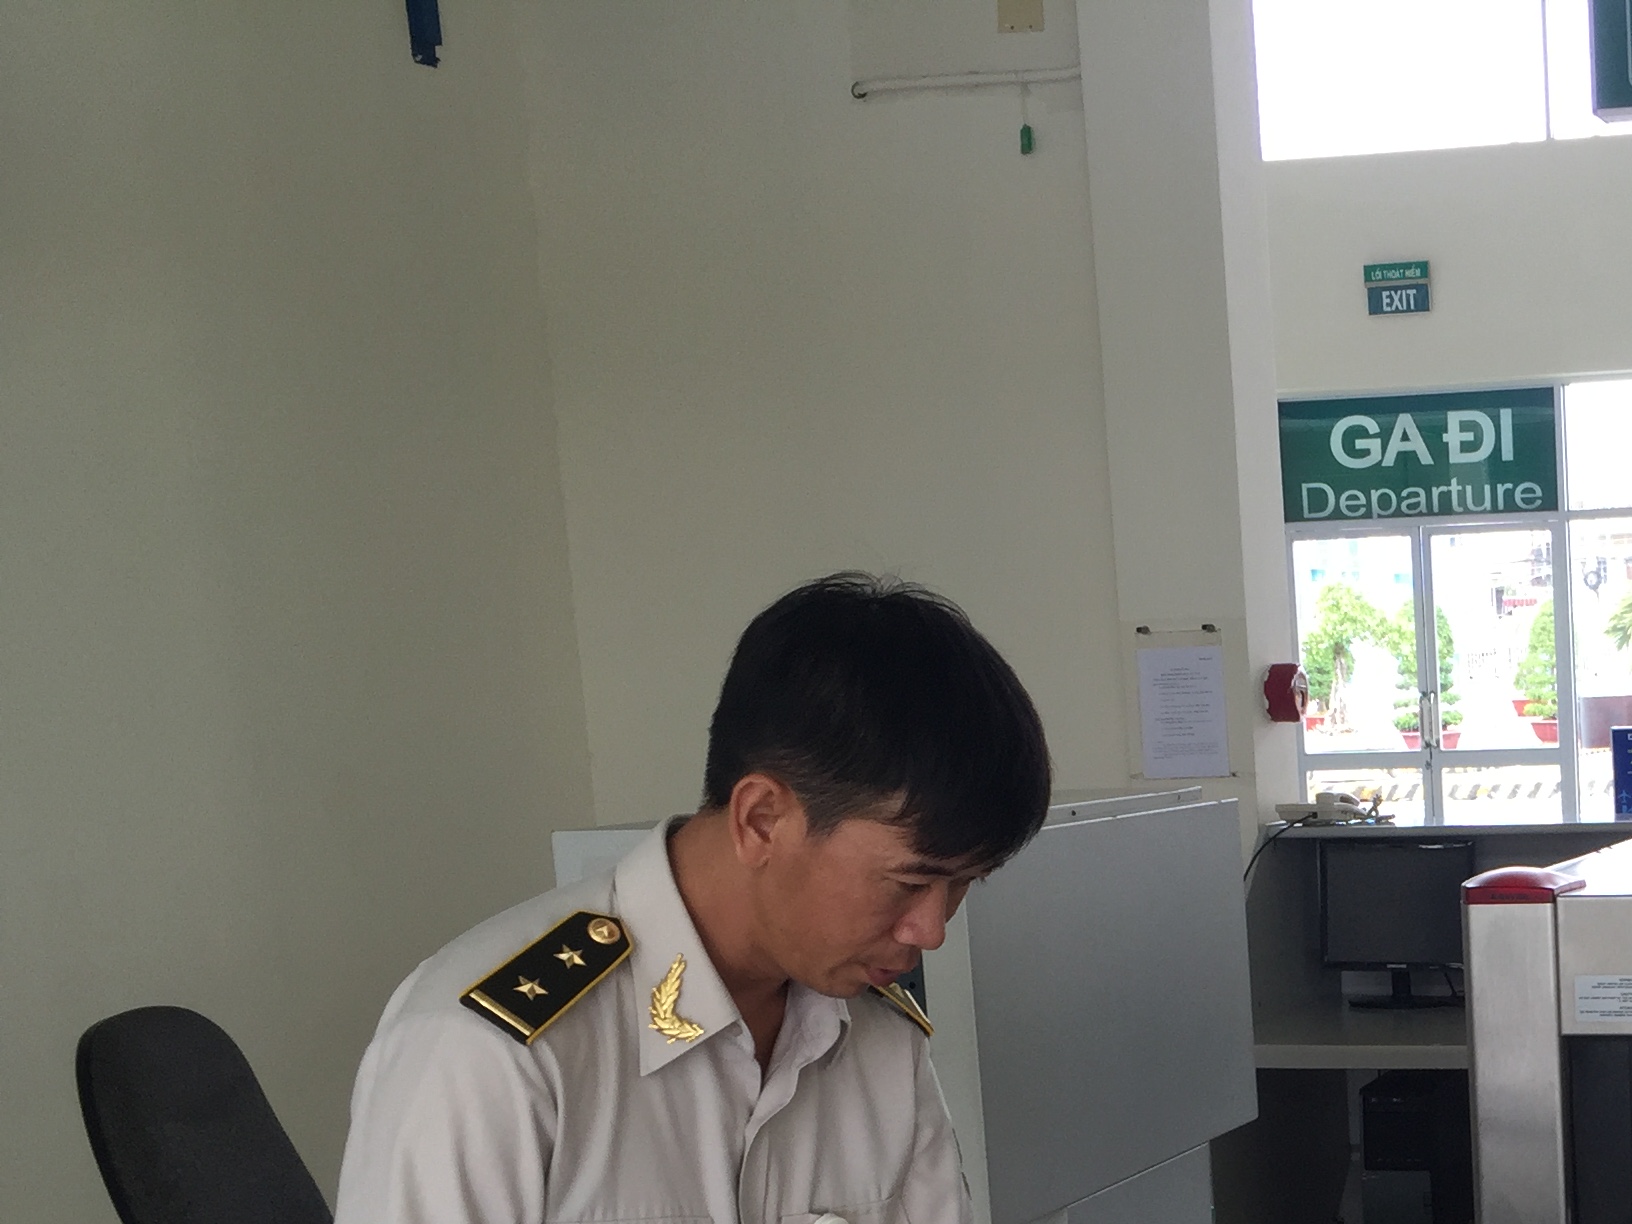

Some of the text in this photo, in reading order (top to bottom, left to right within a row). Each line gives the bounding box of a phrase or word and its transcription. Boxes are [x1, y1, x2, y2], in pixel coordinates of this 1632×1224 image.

[1381, 289, 1417, 312] EXIT
[1330, 408, 1514, 469] GA ĐI
[1301, 476, 1543, 520] Departure
